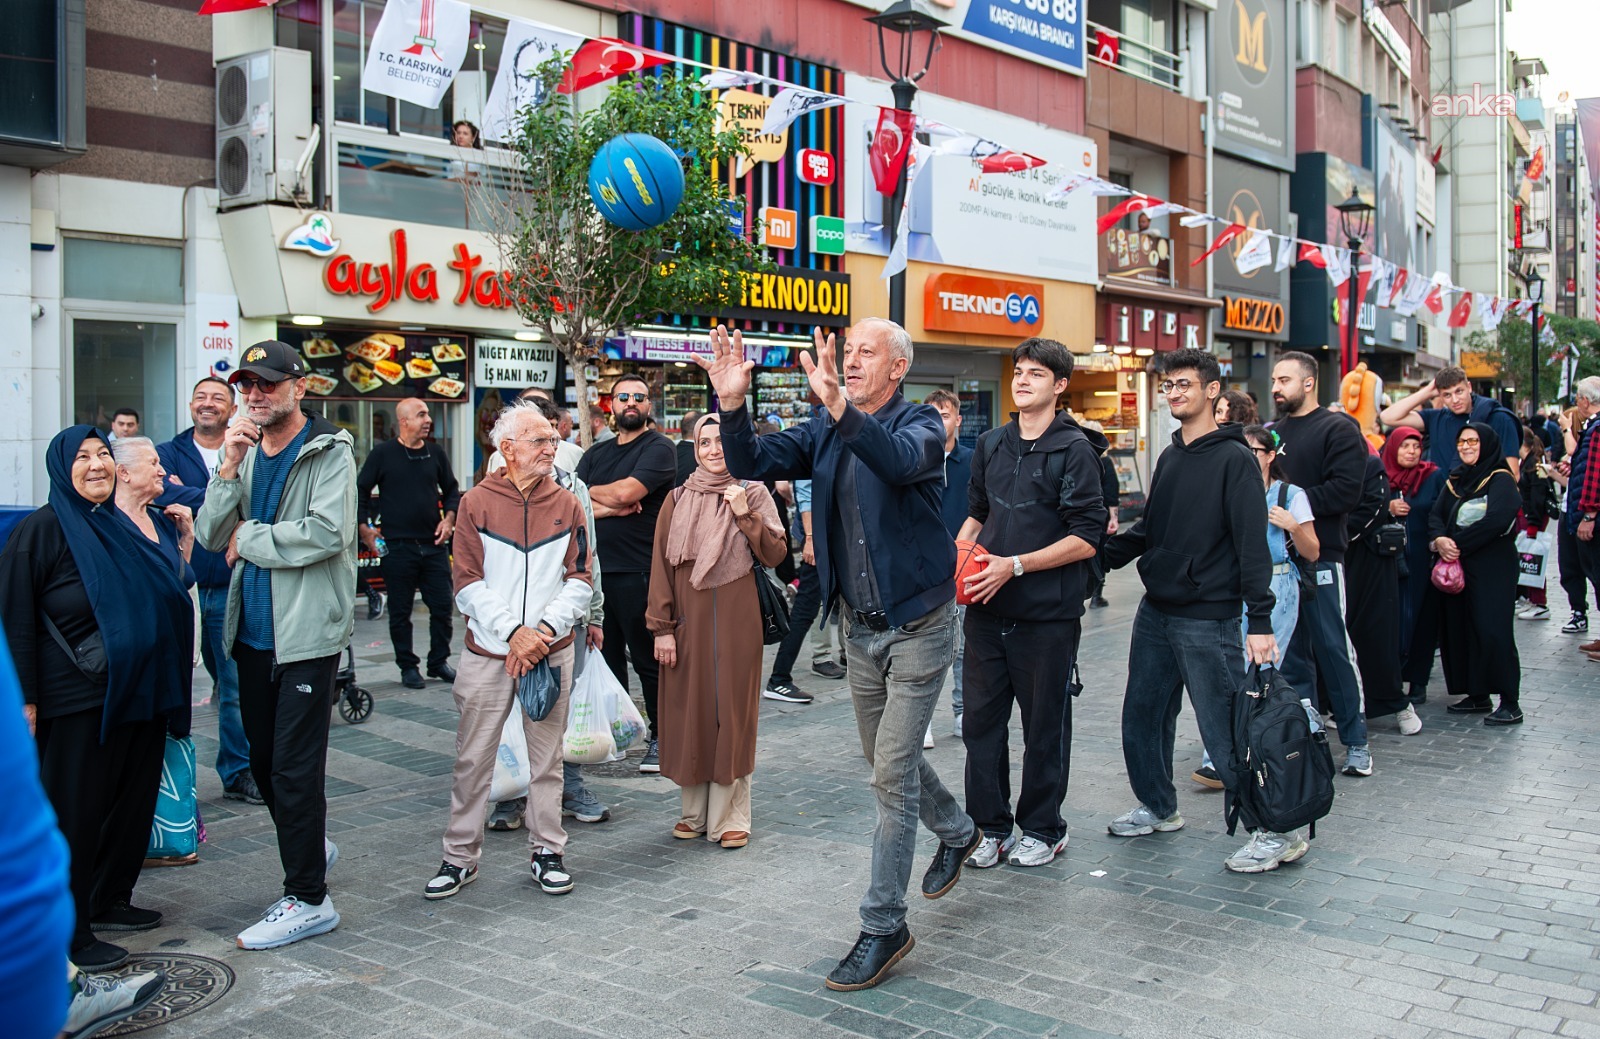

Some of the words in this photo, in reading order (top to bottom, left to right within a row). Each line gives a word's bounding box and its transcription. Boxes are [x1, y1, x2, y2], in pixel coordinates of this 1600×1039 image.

[989, 4, 1039, 38] KARŞIYAKA
[1040, 21, 1075, 50] BRANCH
[379, 51, 396, 63] T.C.
[399, 56, 453, 79] KARŞIYAKA
[387, 66, 442, 89] BELEDİYESİ
[729, 101, 770, 120] TEKNİ
[808, 153, 829, 168] gen
[813, 166, 829, 179] pa
[982, 182, 1017, 201] gücüyle,
[1018, 189, 1041, 205] ikonik
[959, 202, 981, 214] 200MP
[990, 207, 1012, 221] kamera
[817, 228, 844, 241] oppo
[326, 228, 440, 314] ayla
[938, 291, 1039, 318] TEKNOSA
[1225, 295, 1285, 334] MEZZO
[202, 332, 234, 355] GİRİŞ
[478, 342, 508, 360] NİGET
[645, 338, 685, 351] MESSE
[484, 362, 494, 385] İŞ
[496, 368, 522, 382] HANI
[525, 369, 549, 383] No:7
